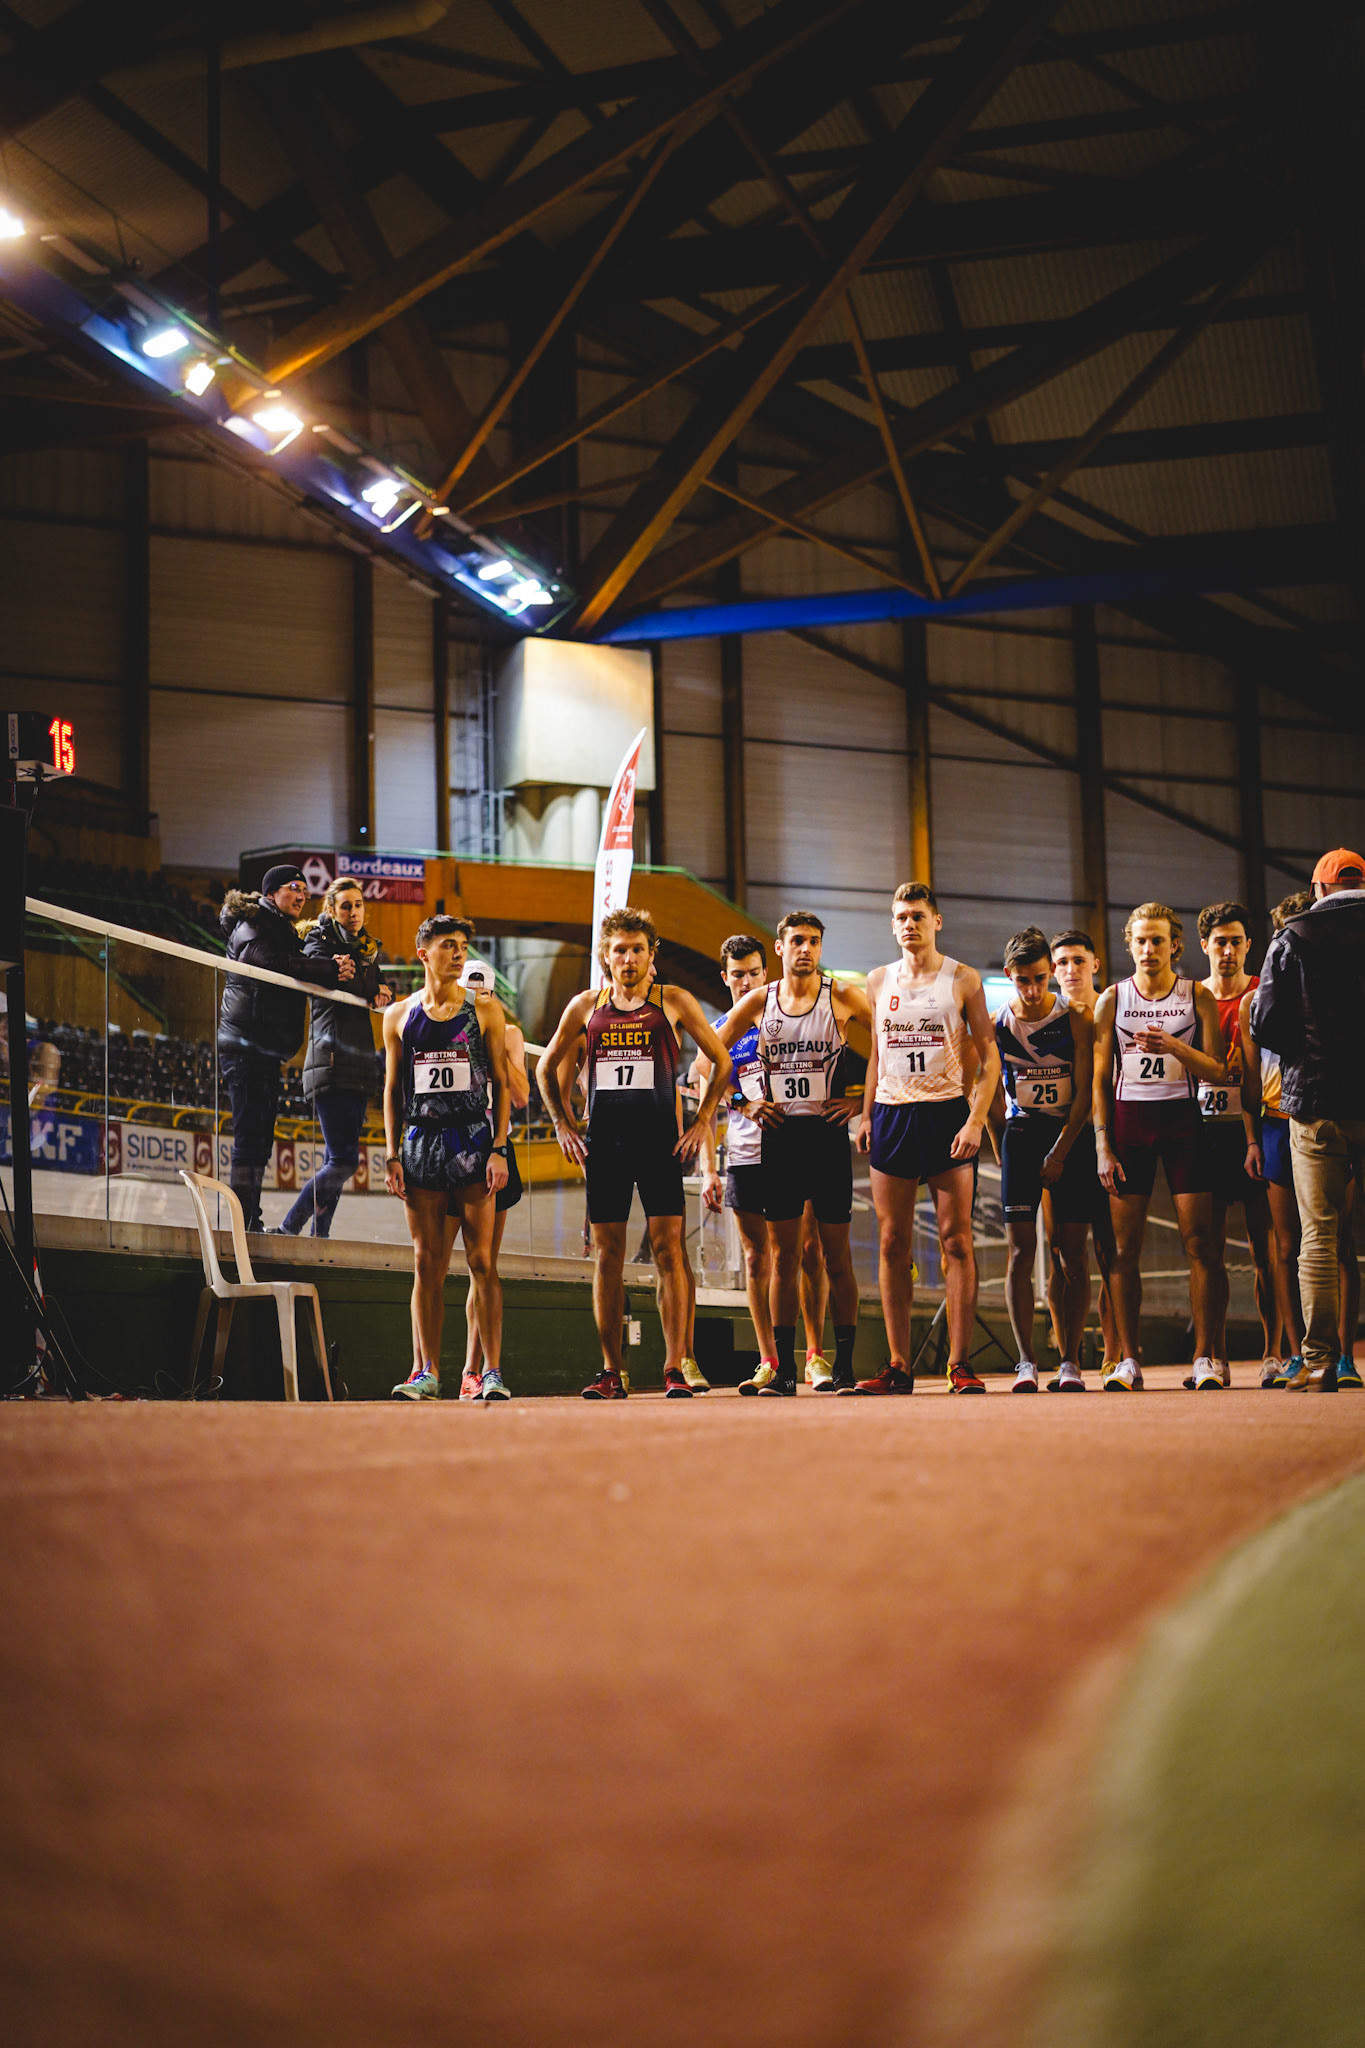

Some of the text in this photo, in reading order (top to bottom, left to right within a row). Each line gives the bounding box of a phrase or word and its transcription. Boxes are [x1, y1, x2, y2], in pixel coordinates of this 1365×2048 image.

[49, 718, 75, 774] 15
[338, 856, 423, 876] Bordeaux
[1124, 1009, 1186, 1018] BORDEAUX
[882, 1018, 945, 1032] Bernie Team
[601, 1031, 651, 1046] SELECT
[765, 1040, 832, 1057] BORDEAUX
[424, 1051, 457, 1059] MEETING
[607, 1049, 642, 1057] MEETING
[906, 1051, 926, 1072] 11
[780, 1061, 813, 1069] MEETING
[1027, 1067, 1061, 1075] MEETING
[1140, 1057, 1165, 1079] 24
[429, 1067, 454, 1088] 20
[614, 1065, 634, 1086] 17
[785, 1077, 810, 1099] 30
[1032, 1083, 1058, 1105] 25
[1204, 1090, 1229, 1112] 28
[127, 1133, 188, 1163] SIDER
